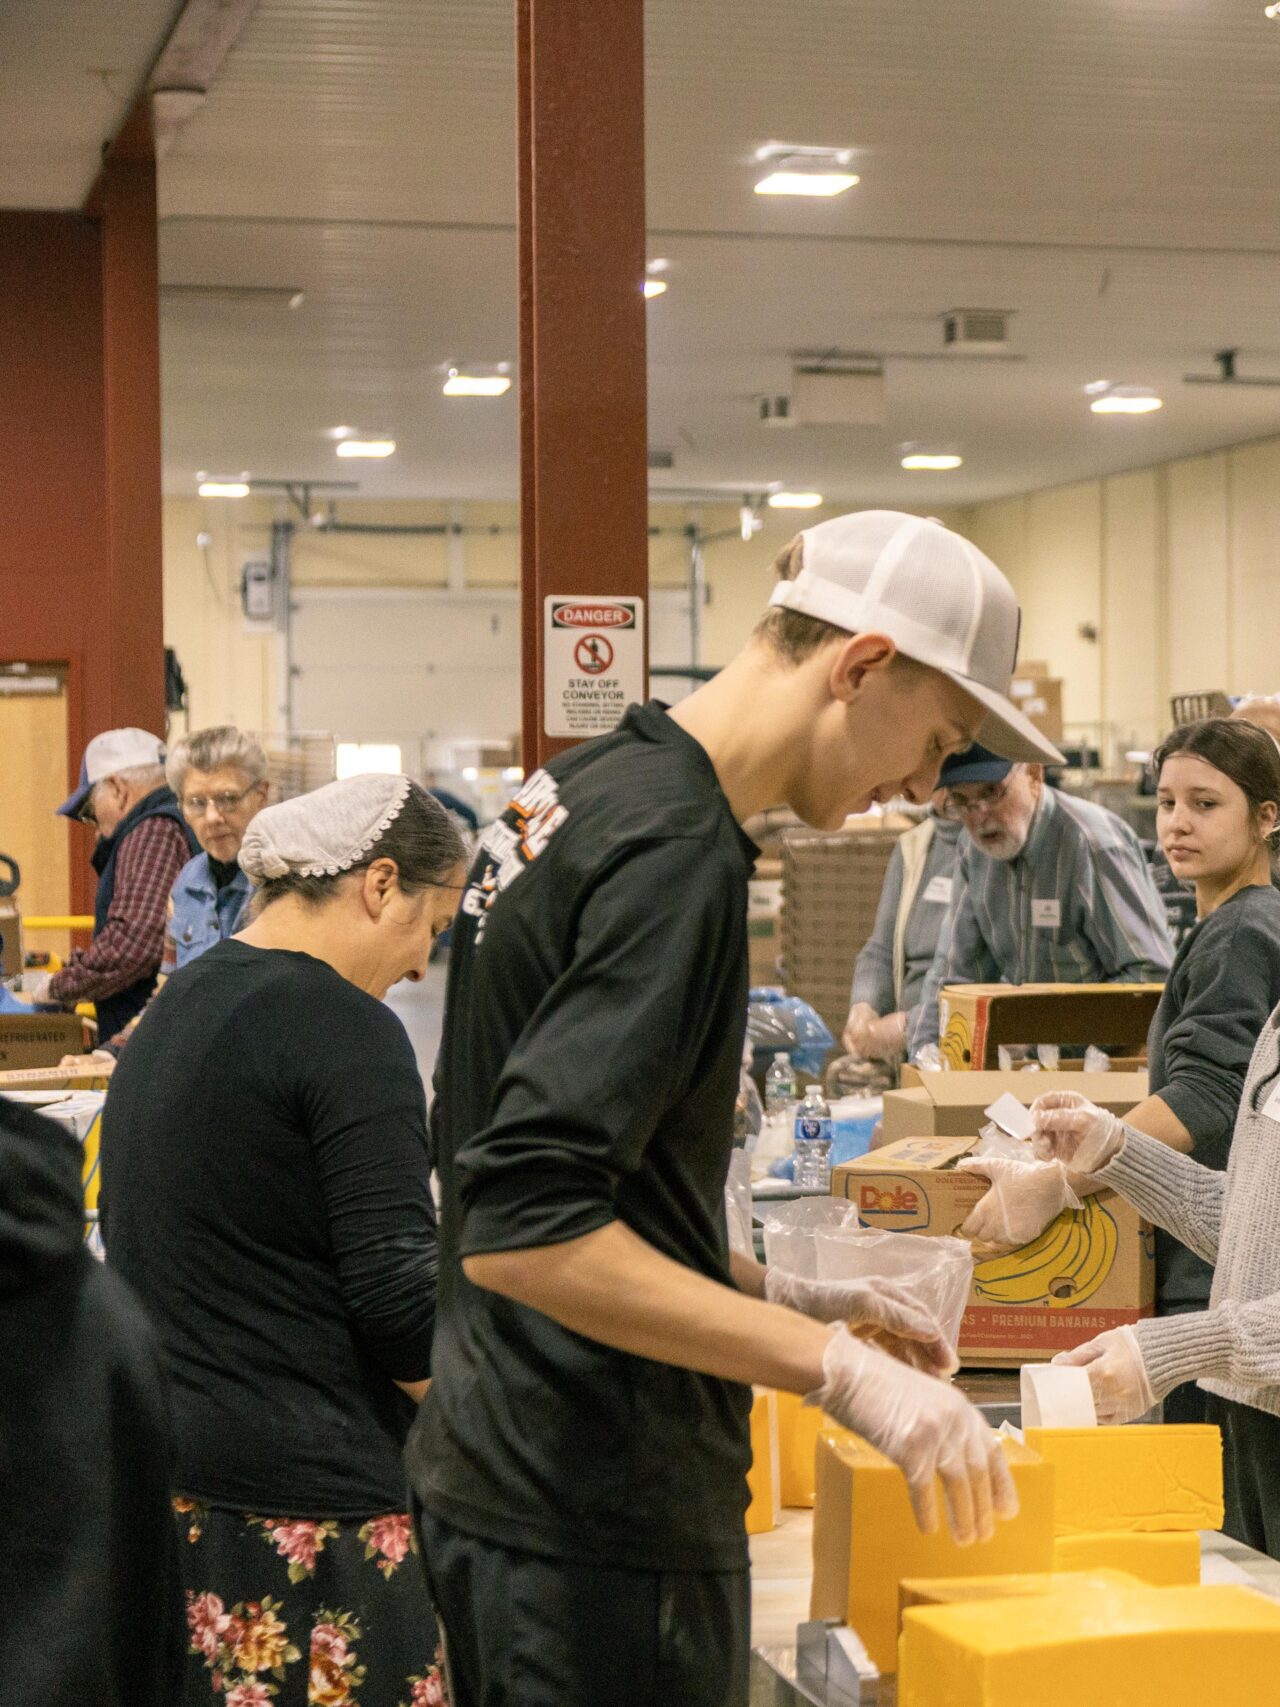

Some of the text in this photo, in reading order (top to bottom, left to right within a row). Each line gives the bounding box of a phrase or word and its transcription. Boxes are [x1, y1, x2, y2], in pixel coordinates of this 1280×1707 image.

[563, 609, 623, 622] DANGER
[568, 679, 619, 688] STAY OFF
[562, 690, 624, 700] CONVEYOR
[860, 1185, 918, 1211] Dole
[992, 1313, 1047, 1328] PREMIUM
[1049, 1315, 1106, 1329] BANANAS
